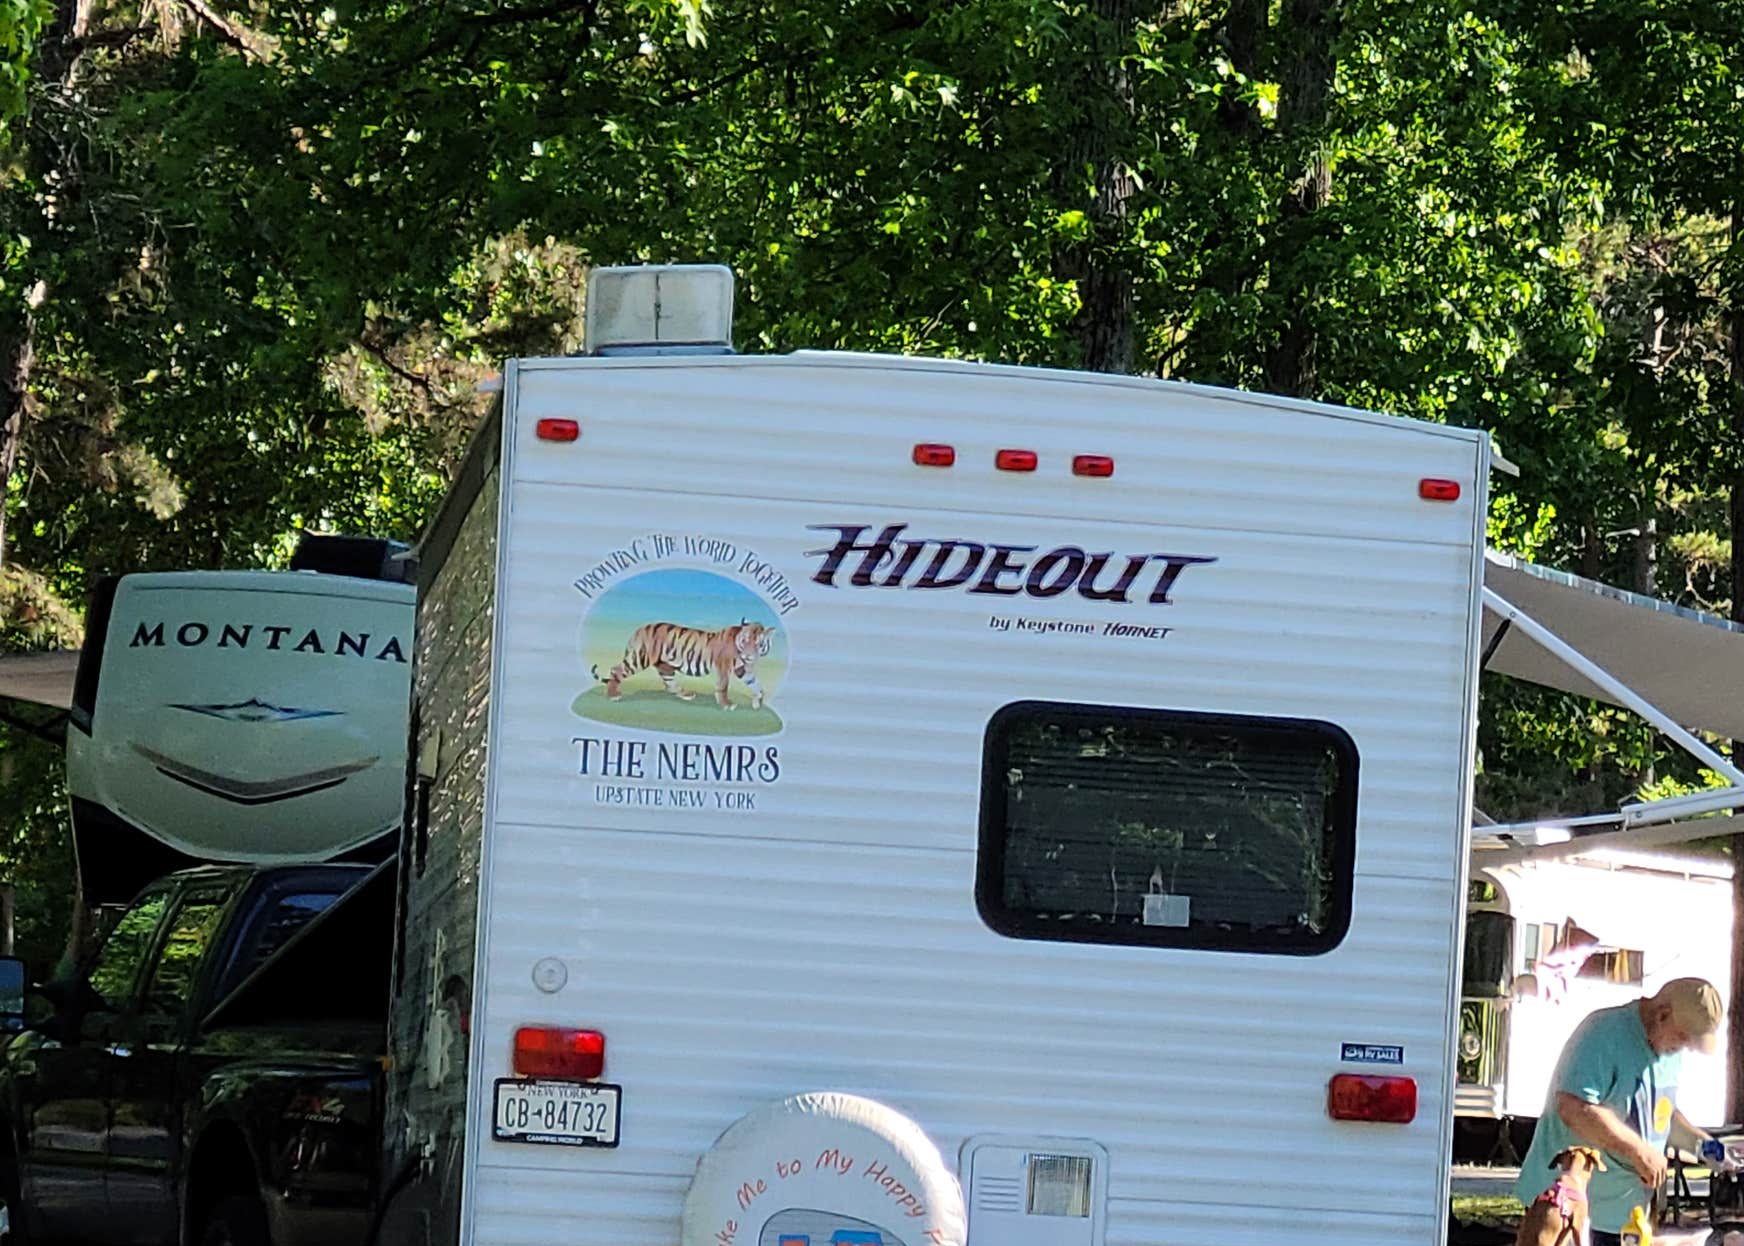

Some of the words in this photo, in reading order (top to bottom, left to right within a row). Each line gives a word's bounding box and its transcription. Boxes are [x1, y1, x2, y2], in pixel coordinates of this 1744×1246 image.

[573, 536, 648, 598] PROWLING
[652, 533, 680, 559] THE
[684, 535, 736, 563] WORLD
[738, 549, 799, 616] TOGETHER
[802, 522, 1219, 605] HIDEOUT
[129, 622, 408, 664] MONTANA
[989, 616, 1011, 632] by
[1016, 617, 1095, 634] Keystone
[572, 738, 647, 779] THE
[658, 742, 780, 783] NEMRS
[595, 785, 663, 807] UPSTATE
[668, 789, 707, 808] NEW
[714, 791, 756, 810] YORK
[527, 1086, 554, 1097] NEW
[559, 1088, 589, 1099] YORK
[736, 1179, 767, 1211] Me
[776, 1159, 802, 1179] to
[815, 1149, 854, 1174] My
[863, 1160, 926, 1218] Happy
